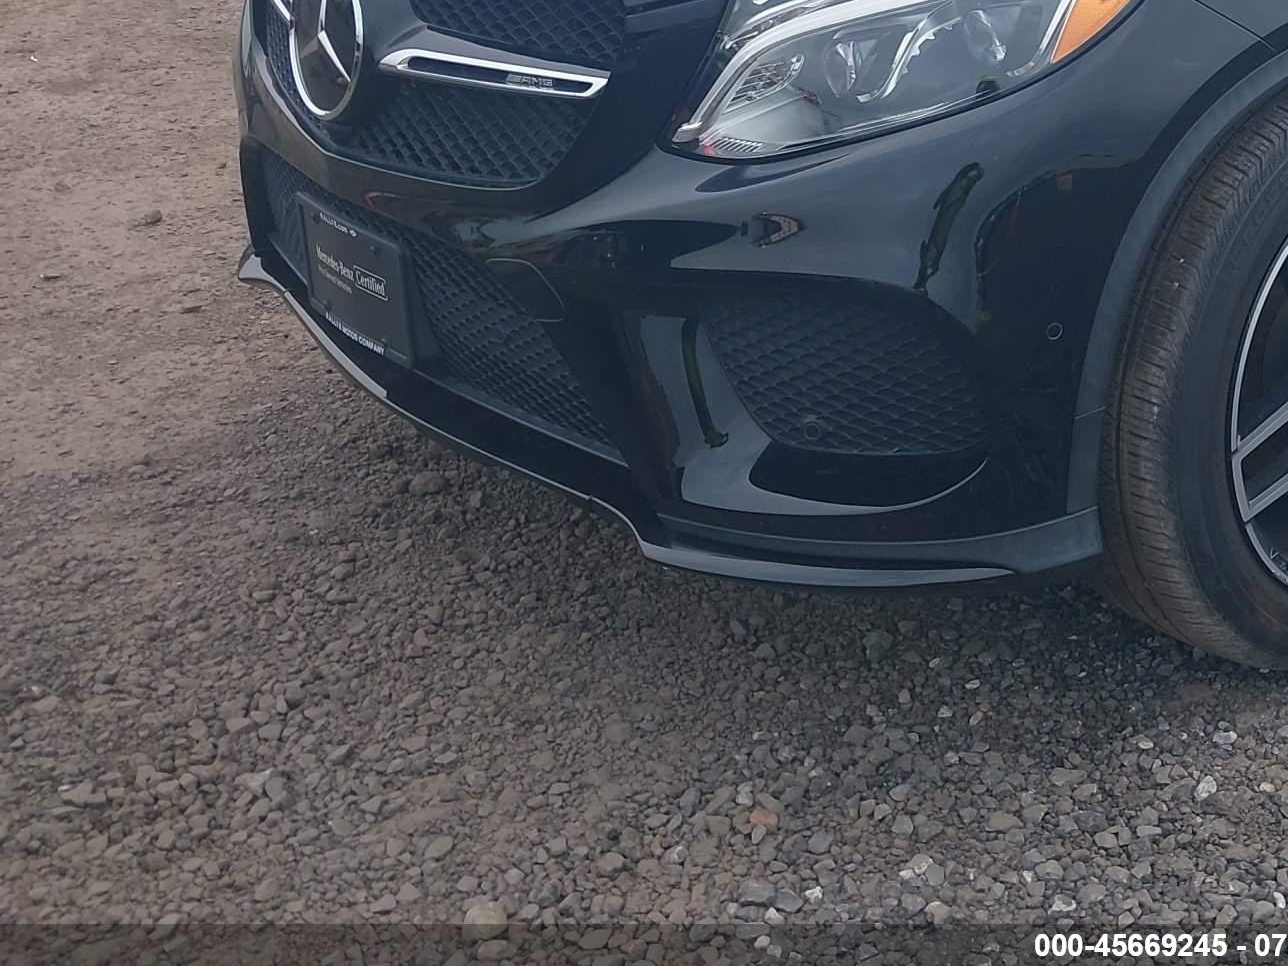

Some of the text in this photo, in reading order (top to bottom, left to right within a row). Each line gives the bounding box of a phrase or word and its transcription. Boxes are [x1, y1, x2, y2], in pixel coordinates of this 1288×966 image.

[520, 75, 553, 87] AMG
[316, 244, 355, 282] Mercedes-Benz
[356, 270, 385, 296] Certified
